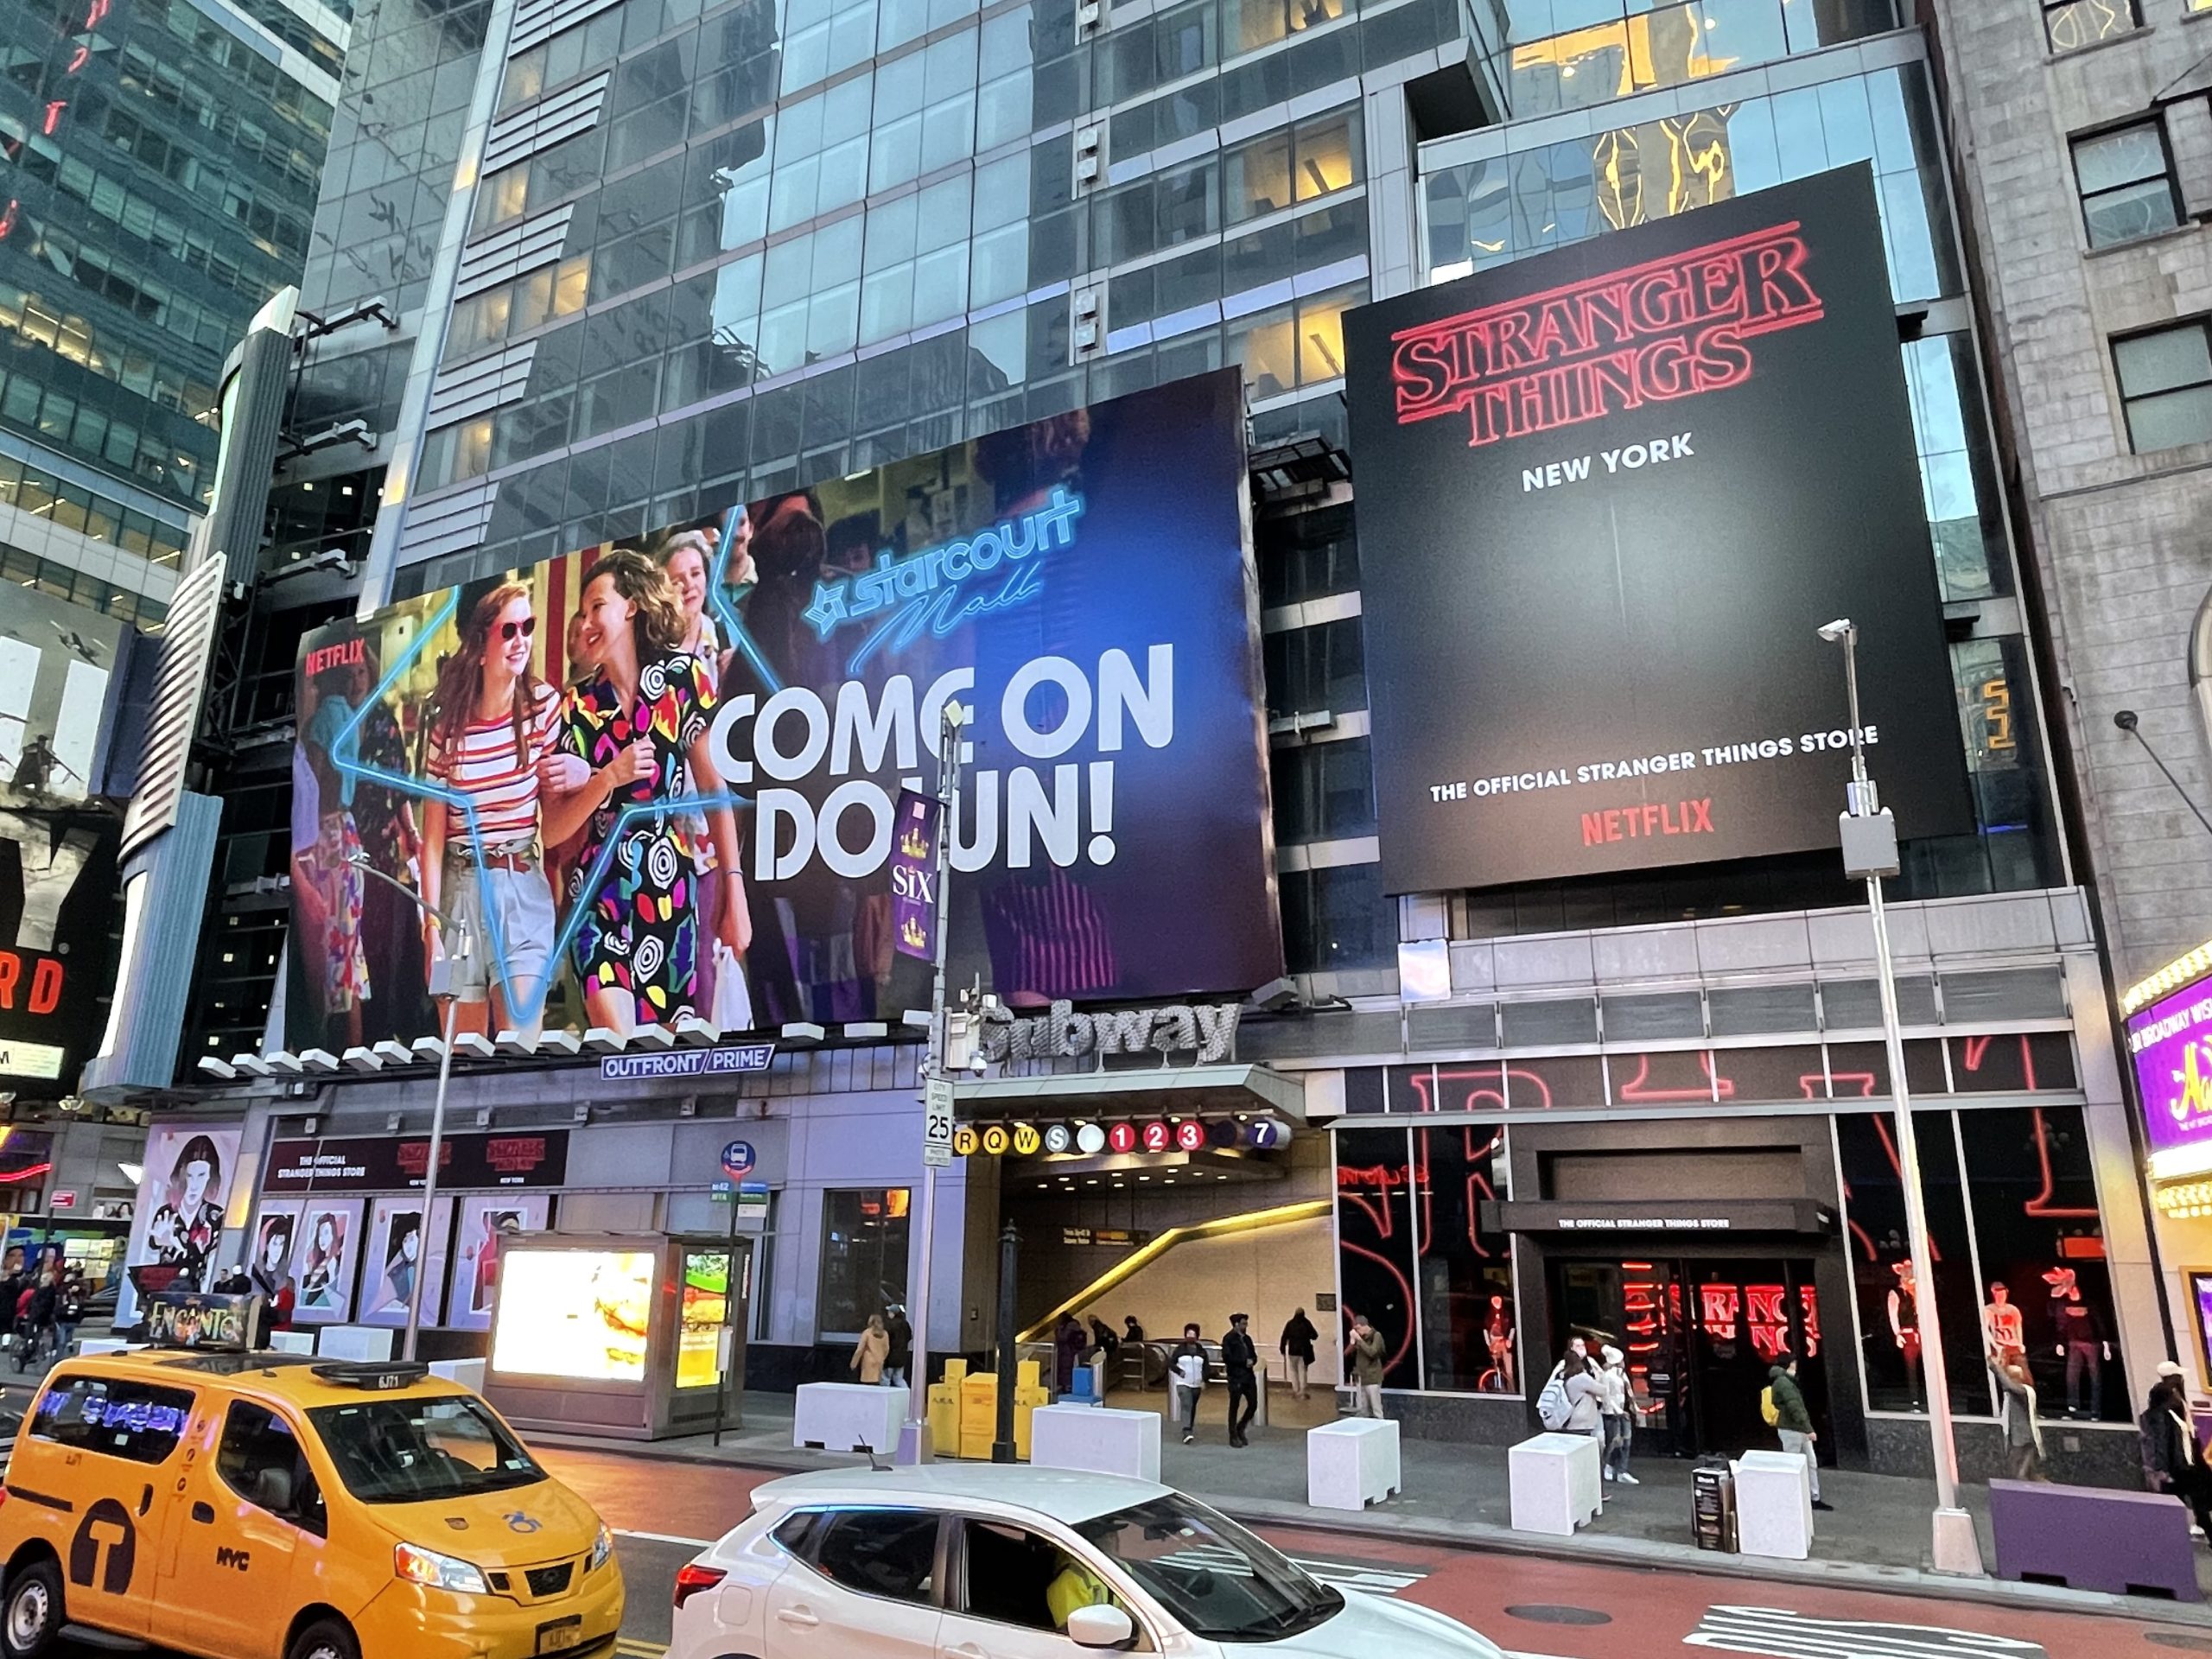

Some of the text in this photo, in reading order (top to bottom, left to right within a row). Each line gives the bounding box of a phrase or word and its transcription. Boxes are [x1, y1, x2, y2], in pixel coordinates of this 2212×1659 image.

[1392, 235, 1822, 412] STRANGER
[1468, 325, 1753, 447] THINGS
[1522, 432, 1694, 493] NEW YORK
[850, 561, 1044, 673] Mall
[305, 638, 365, 677] NETFLIX
[1001, 644, 1173, 759] ON
[1430, 725, 1878, 803] THE OFFICIAL STRANGER THINGS STORE
[1581, 798, 1714, 847] NETFLIX
[978, 999, 1240, 1062] Subway
[606, 1049, 765, 1077] OUTFRONT PRIME
[929, 1115, 949, 1139] 25
[1559, 1219, 1730, 1228] THE OFFICIAL STRANGER THINGS STORE
[149, 1300, 240, 1341] ENCANTO
[378, 1376, 399, 1389] 6J71
[216, 1546, 251, 1572] NYC
